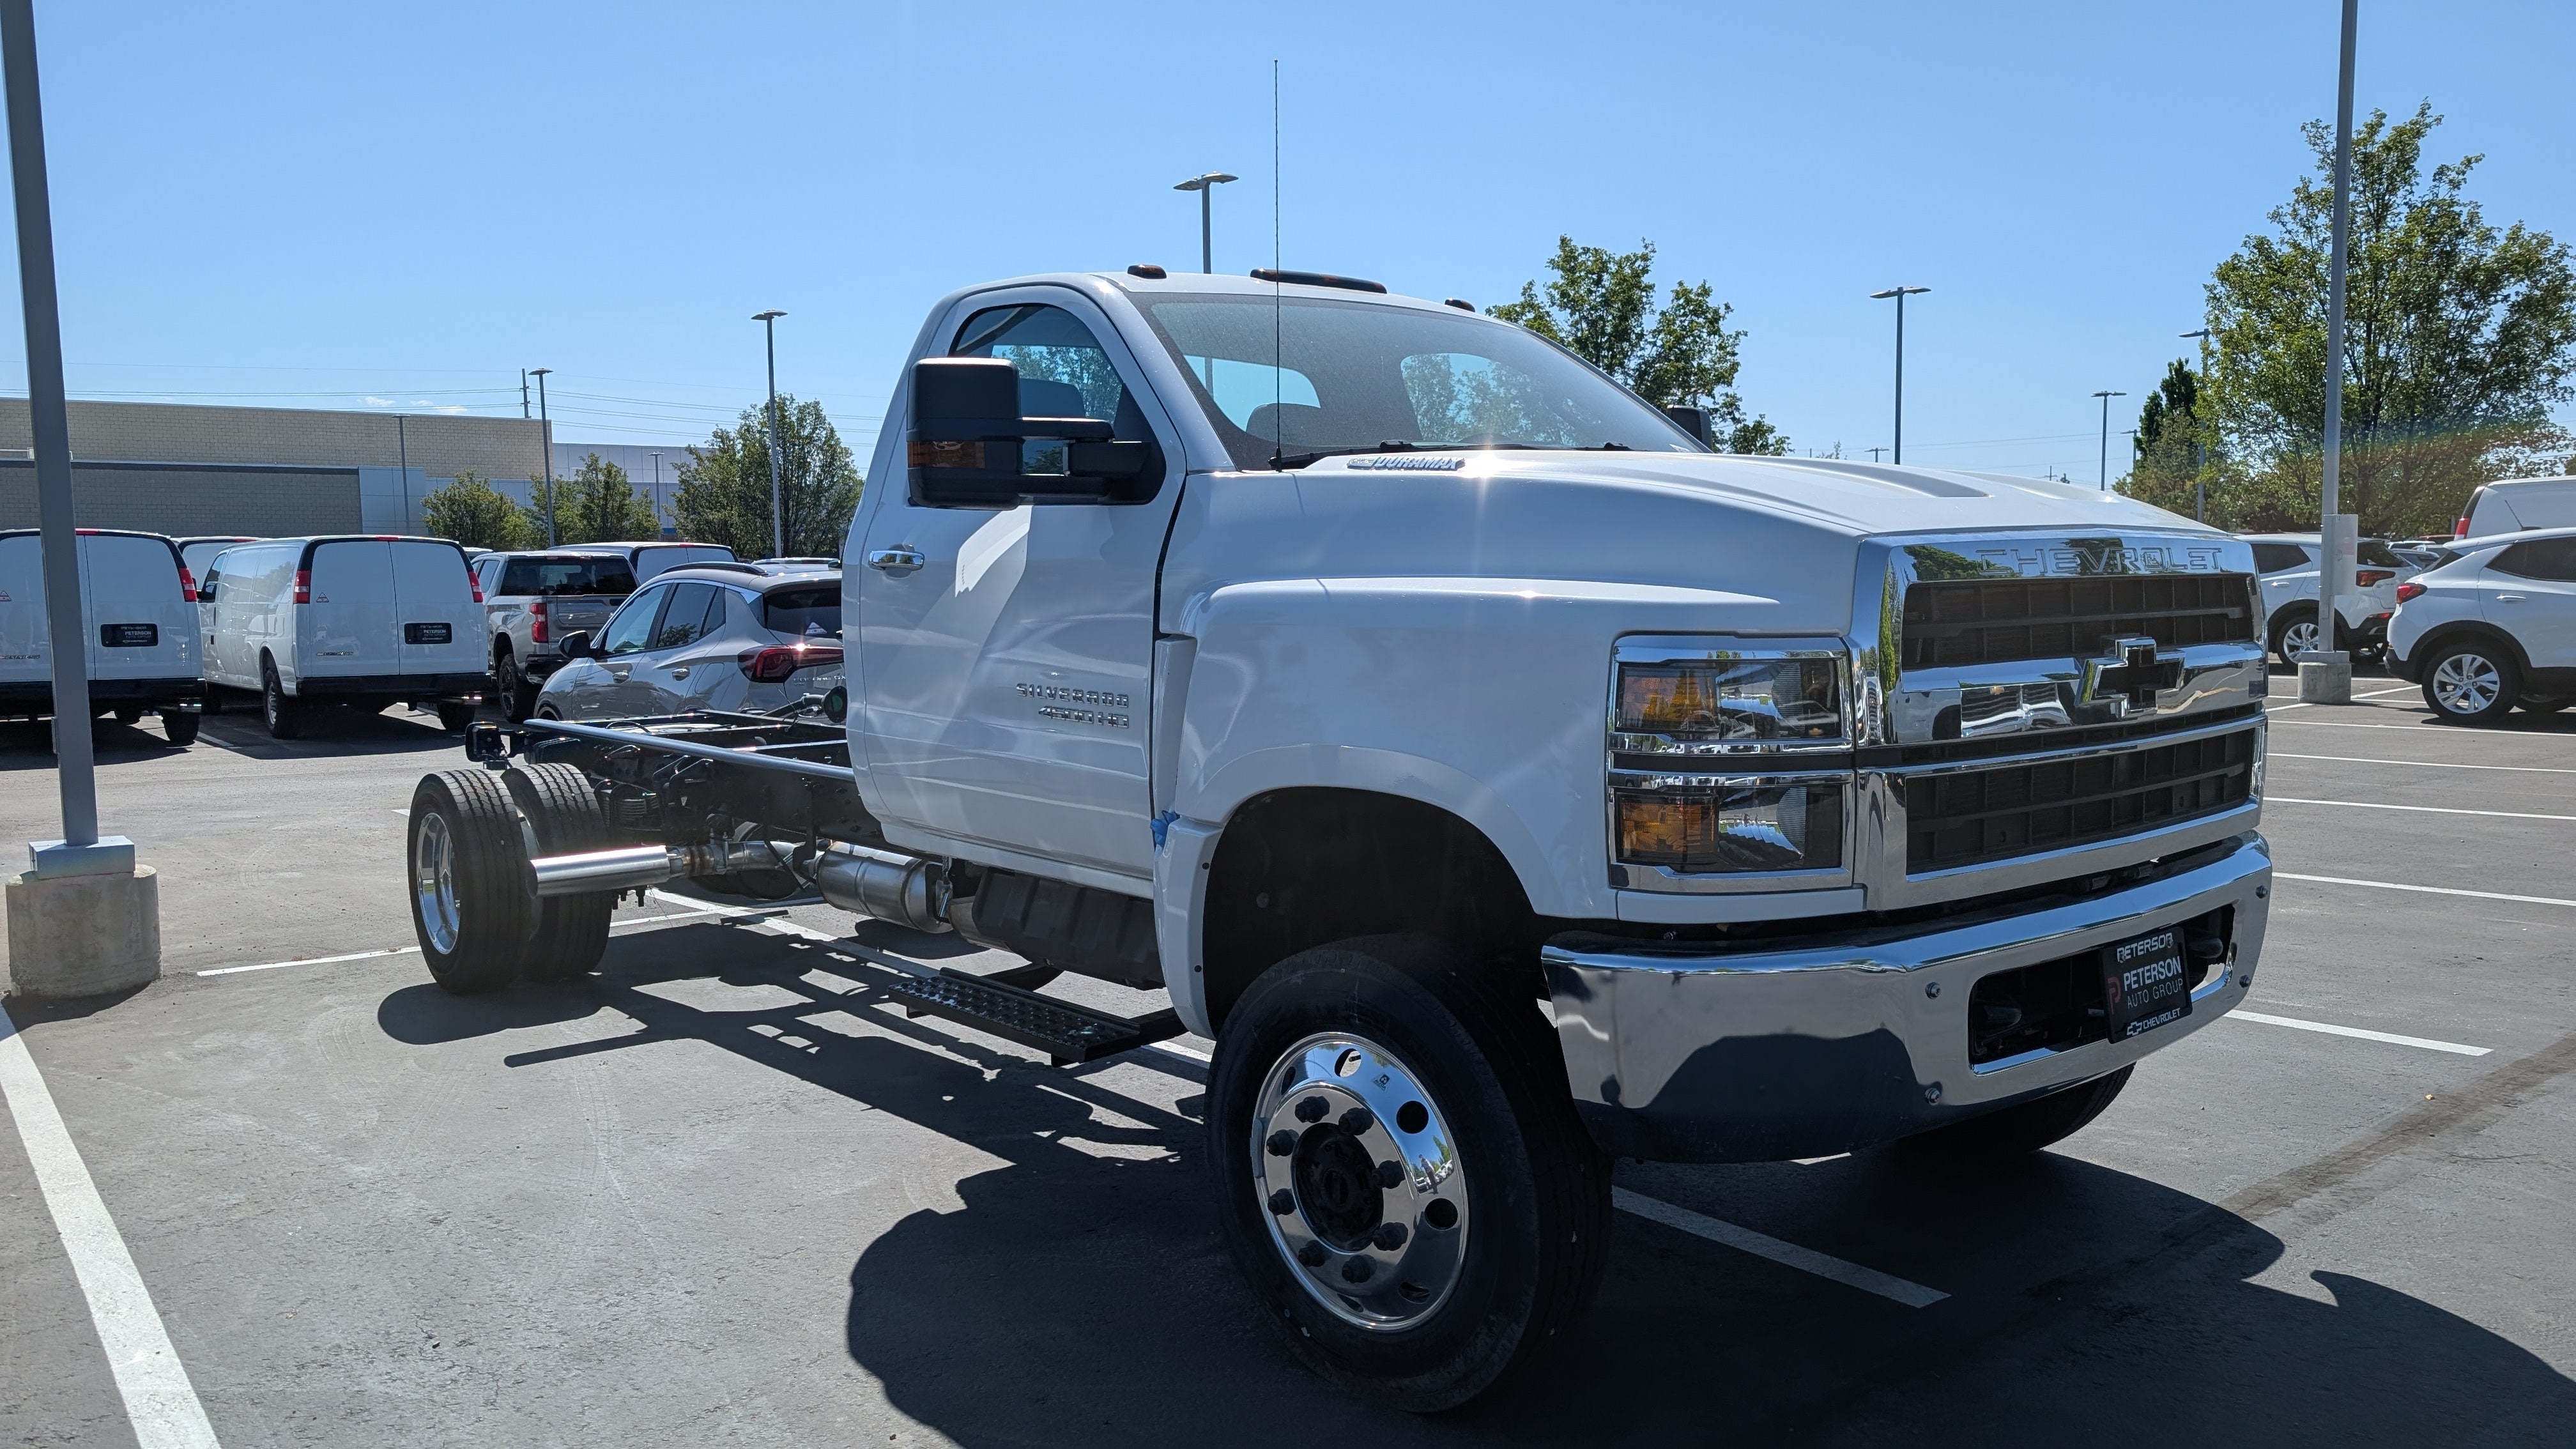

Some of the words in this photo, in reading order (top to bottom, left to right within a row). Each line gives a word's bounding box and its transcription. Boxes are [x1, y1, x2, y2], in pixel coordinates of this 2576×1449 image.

[1374, 456, 1466, 470] DURAMAX
[1975, 547, 2223, 574] CHEVROLET
[1016, 682, 1129, 709] SILVERADO
[2123, 955, 2182, 992] PETERSON
[2128, 989, 2149, 1009] AUTO
[2152, 978, 2184, 999] GROUP
[2142, 1008, 2181, 1030] CHEVROLET
